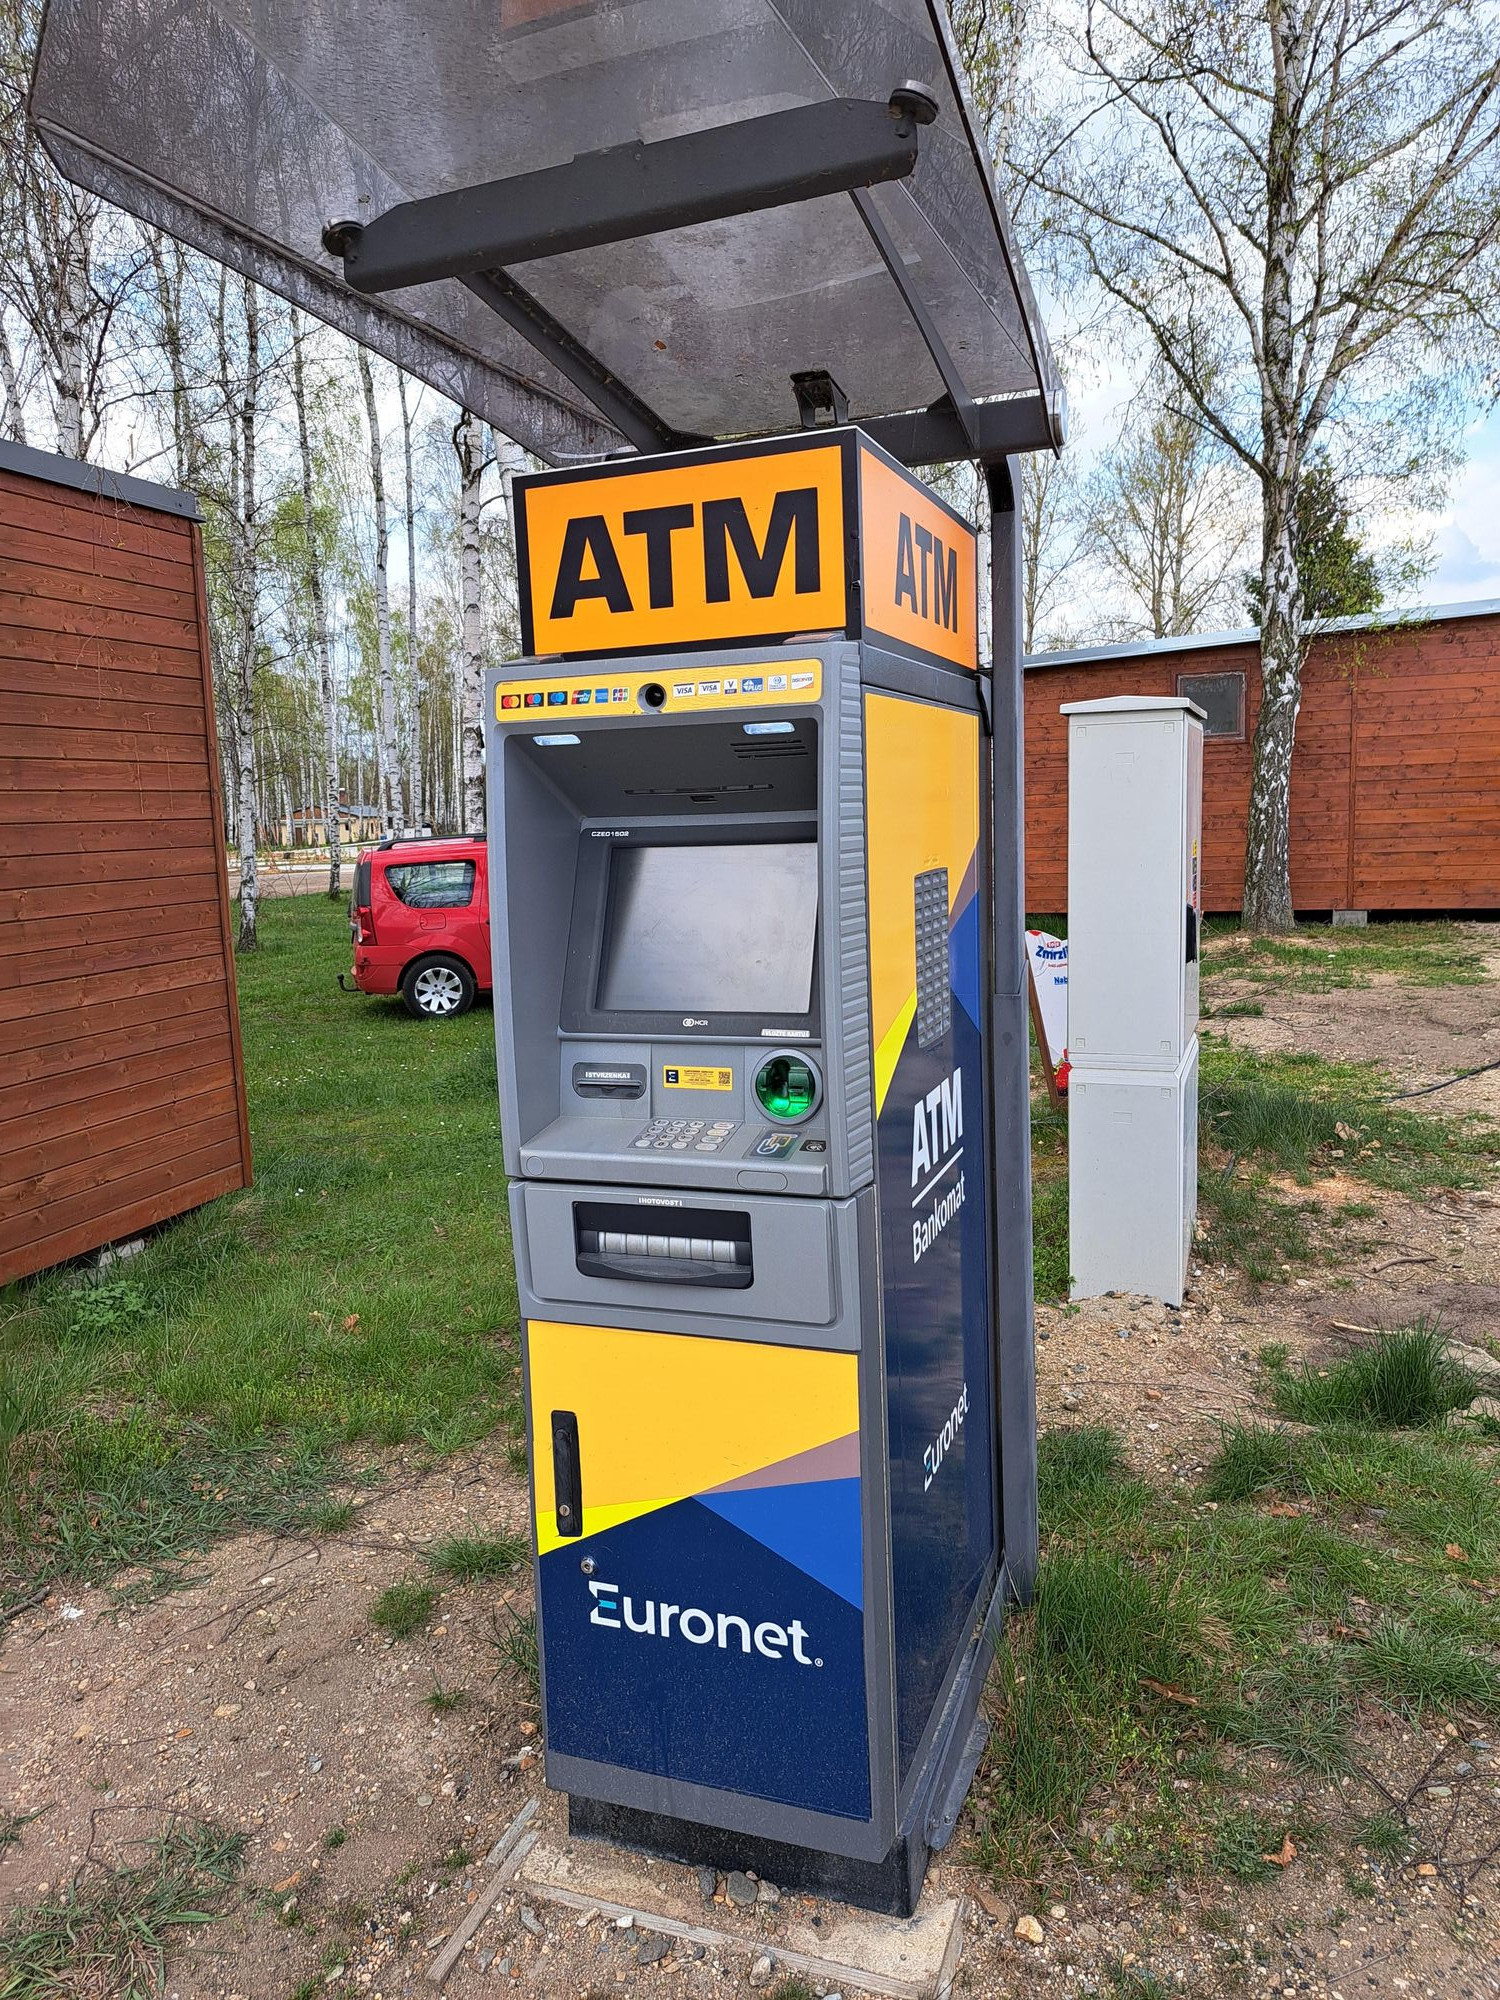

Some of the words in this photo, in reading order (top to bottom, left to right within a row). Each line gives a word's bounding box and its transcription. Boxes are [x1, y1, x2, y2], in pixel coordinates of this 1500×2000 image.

[549, 487, 821, 620] ATM
[894, 512, 958, 634] ATM
[676, 687, 693, 695] VISA
[702, 684, 718, 692] VISA
[911, 1067, 964, 1187] ATM
[912, 1171, 966, 1265] Bankomat
[923, 1382, 970, 1493] Euronet
[588, 1580, 813, 1665] Euronet
